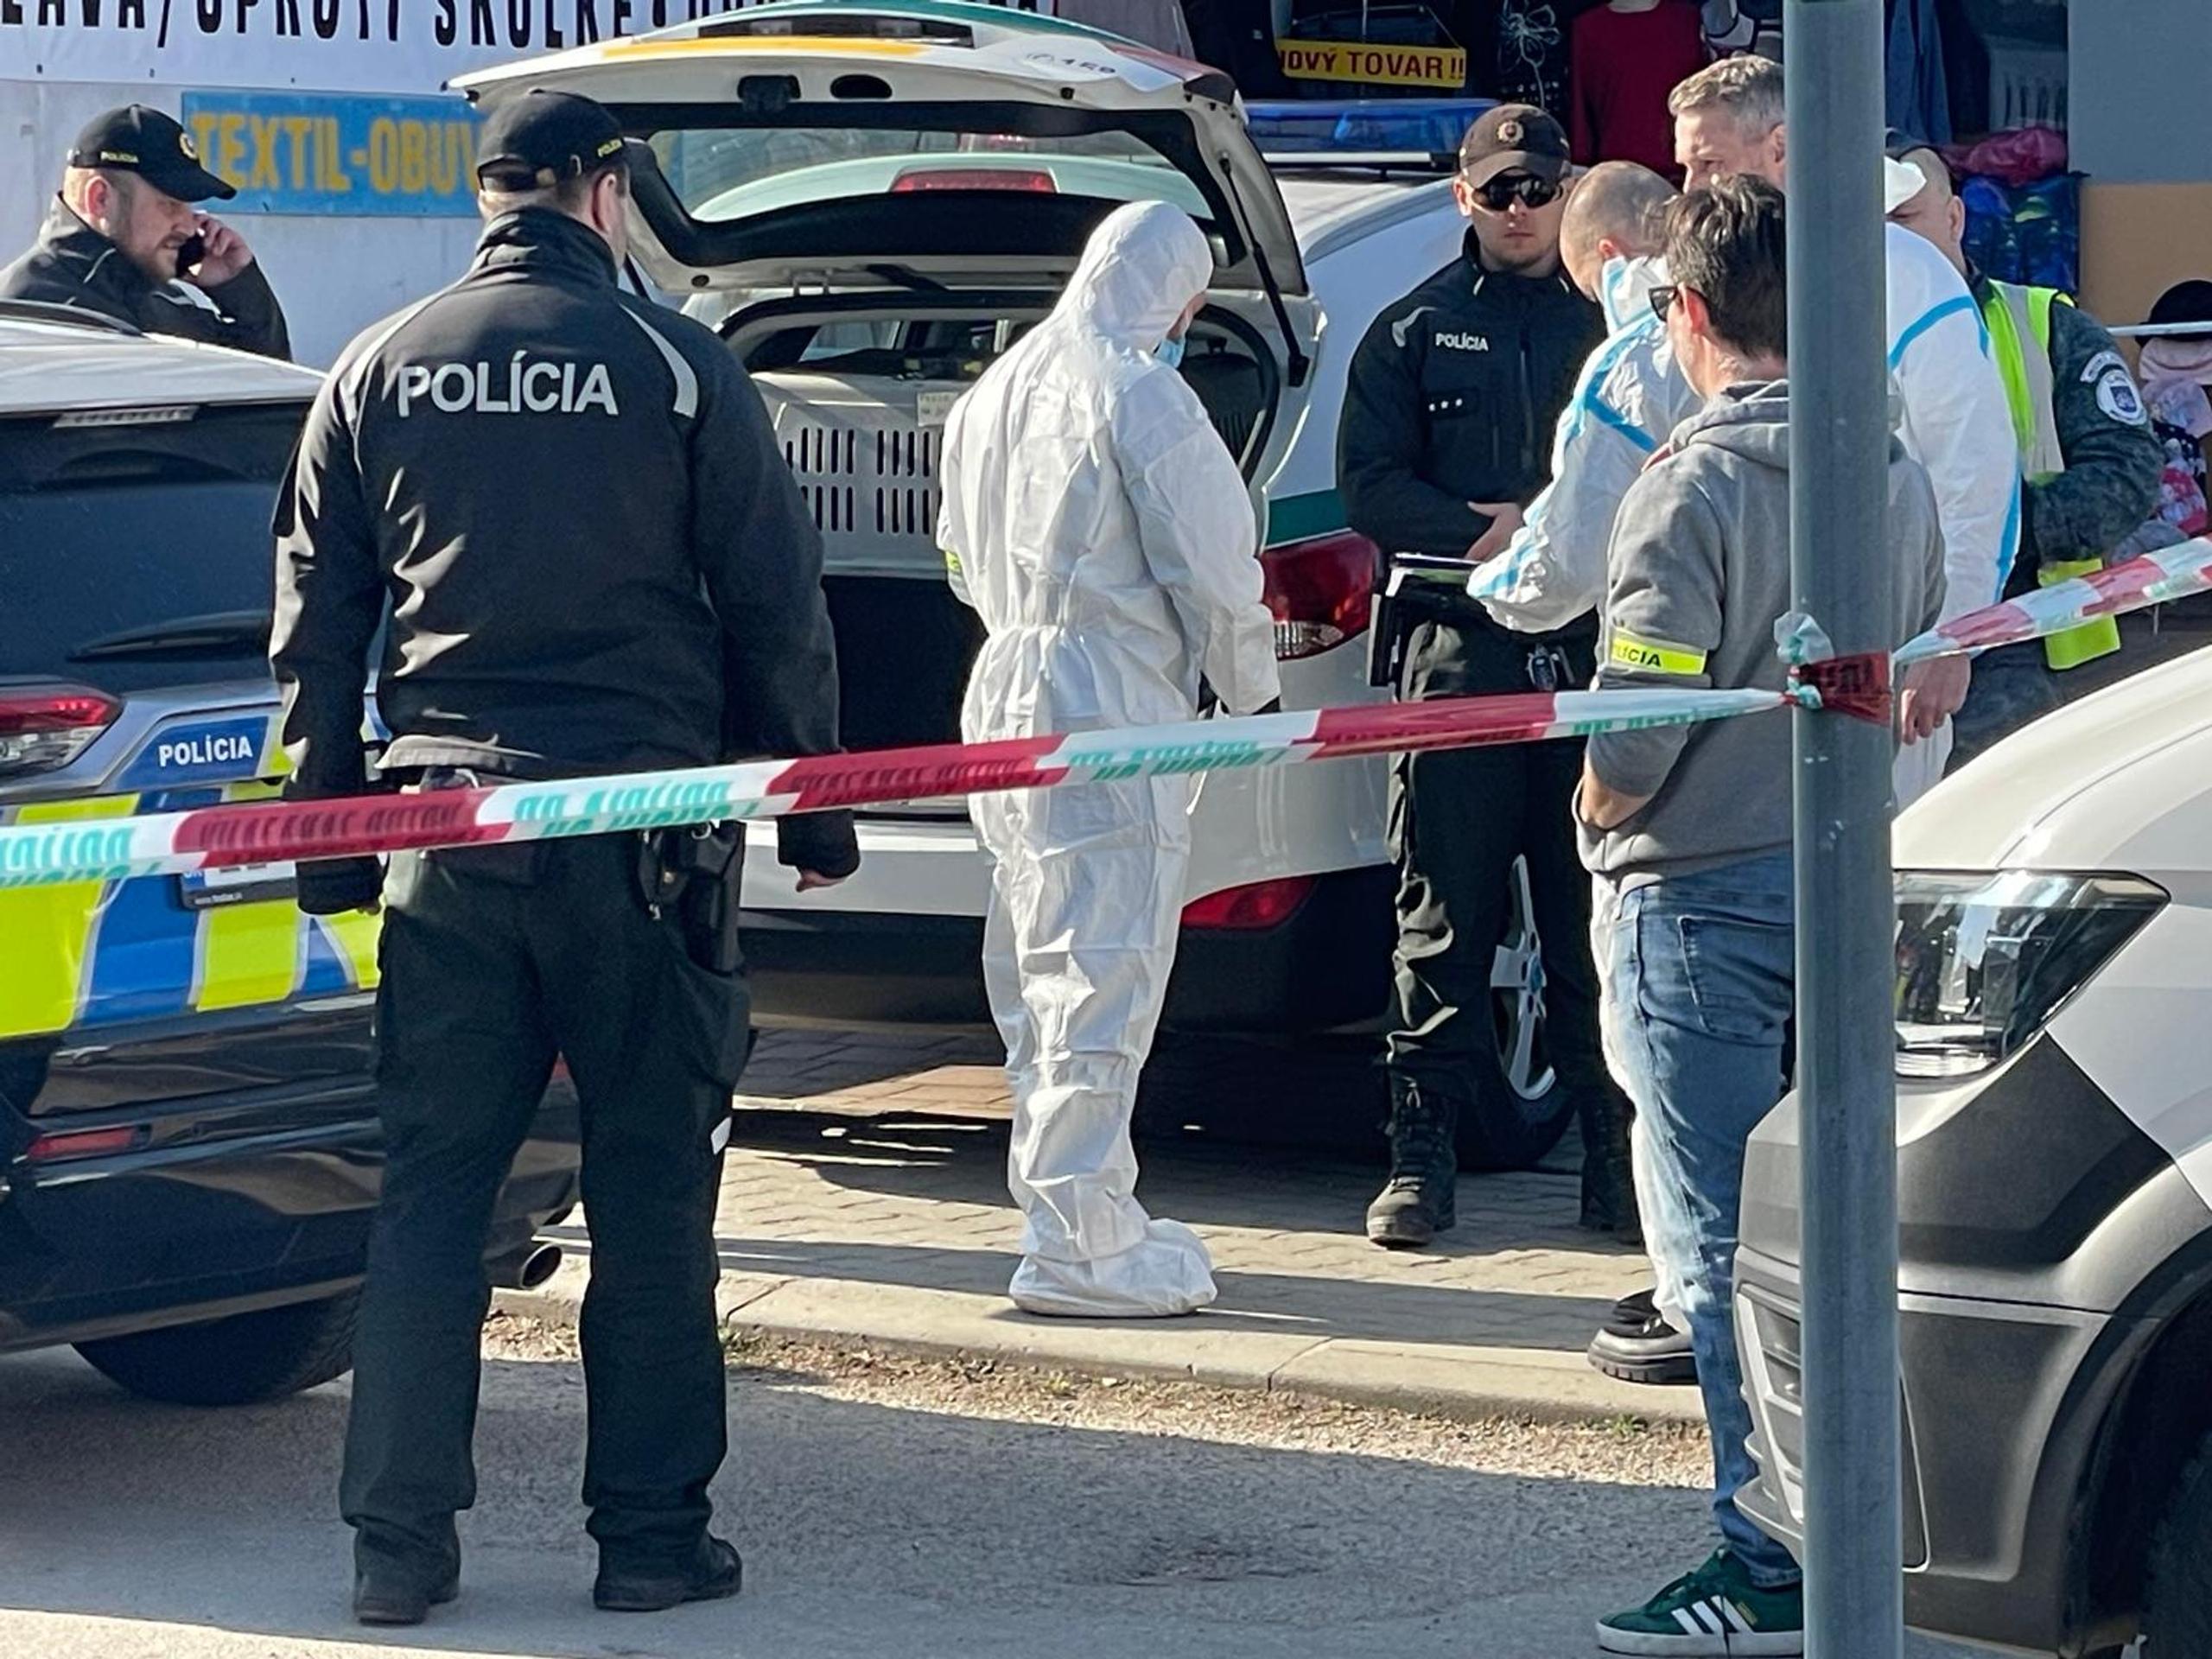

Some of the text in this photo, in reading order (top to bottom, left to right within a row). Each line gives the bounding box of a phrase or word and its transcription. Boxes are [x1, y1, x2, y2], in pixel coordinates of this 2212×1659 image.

[1346, 51, 1443, 80] TOVAR
[1435, 332, 1489, 352] POLÍCIA
[397, 350, 620, 418] POLÍCIA
[158, 734, 253, 767] POLÍCIA
